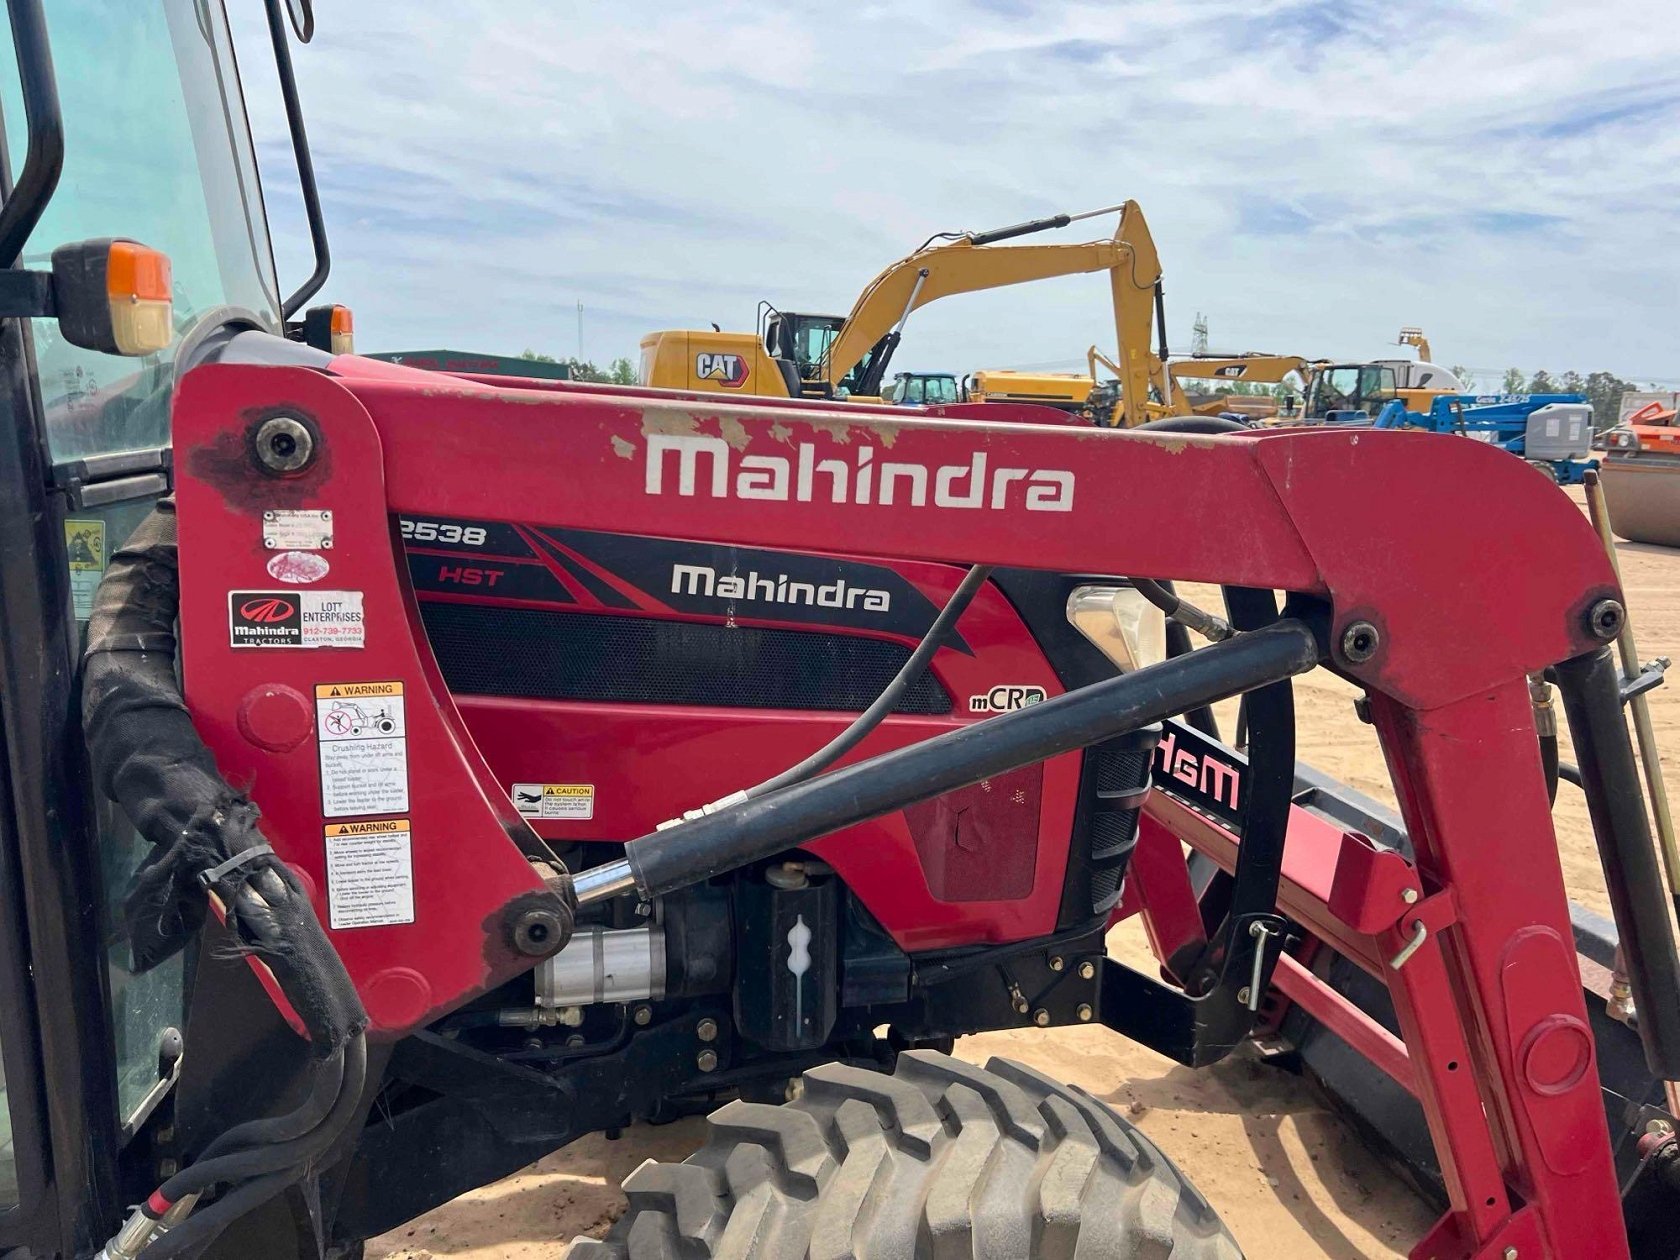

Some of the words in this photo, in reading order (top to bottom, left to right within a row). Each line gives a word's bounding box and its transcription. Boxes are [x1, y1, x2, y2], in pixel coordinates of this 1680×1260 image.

[697, 354, 737, 380] CAT
[400, 520, 487, 546] 2538
[438, 566, 504, 586] HST
[321, 602, 342, 612] LOTT
[303, 612, 361, 622] ENTERPRISES
[344, 684, 393, 695] WARNING
[332, 744, 365, 752] Crushing
[350, 822, 397, 833] WARNING
